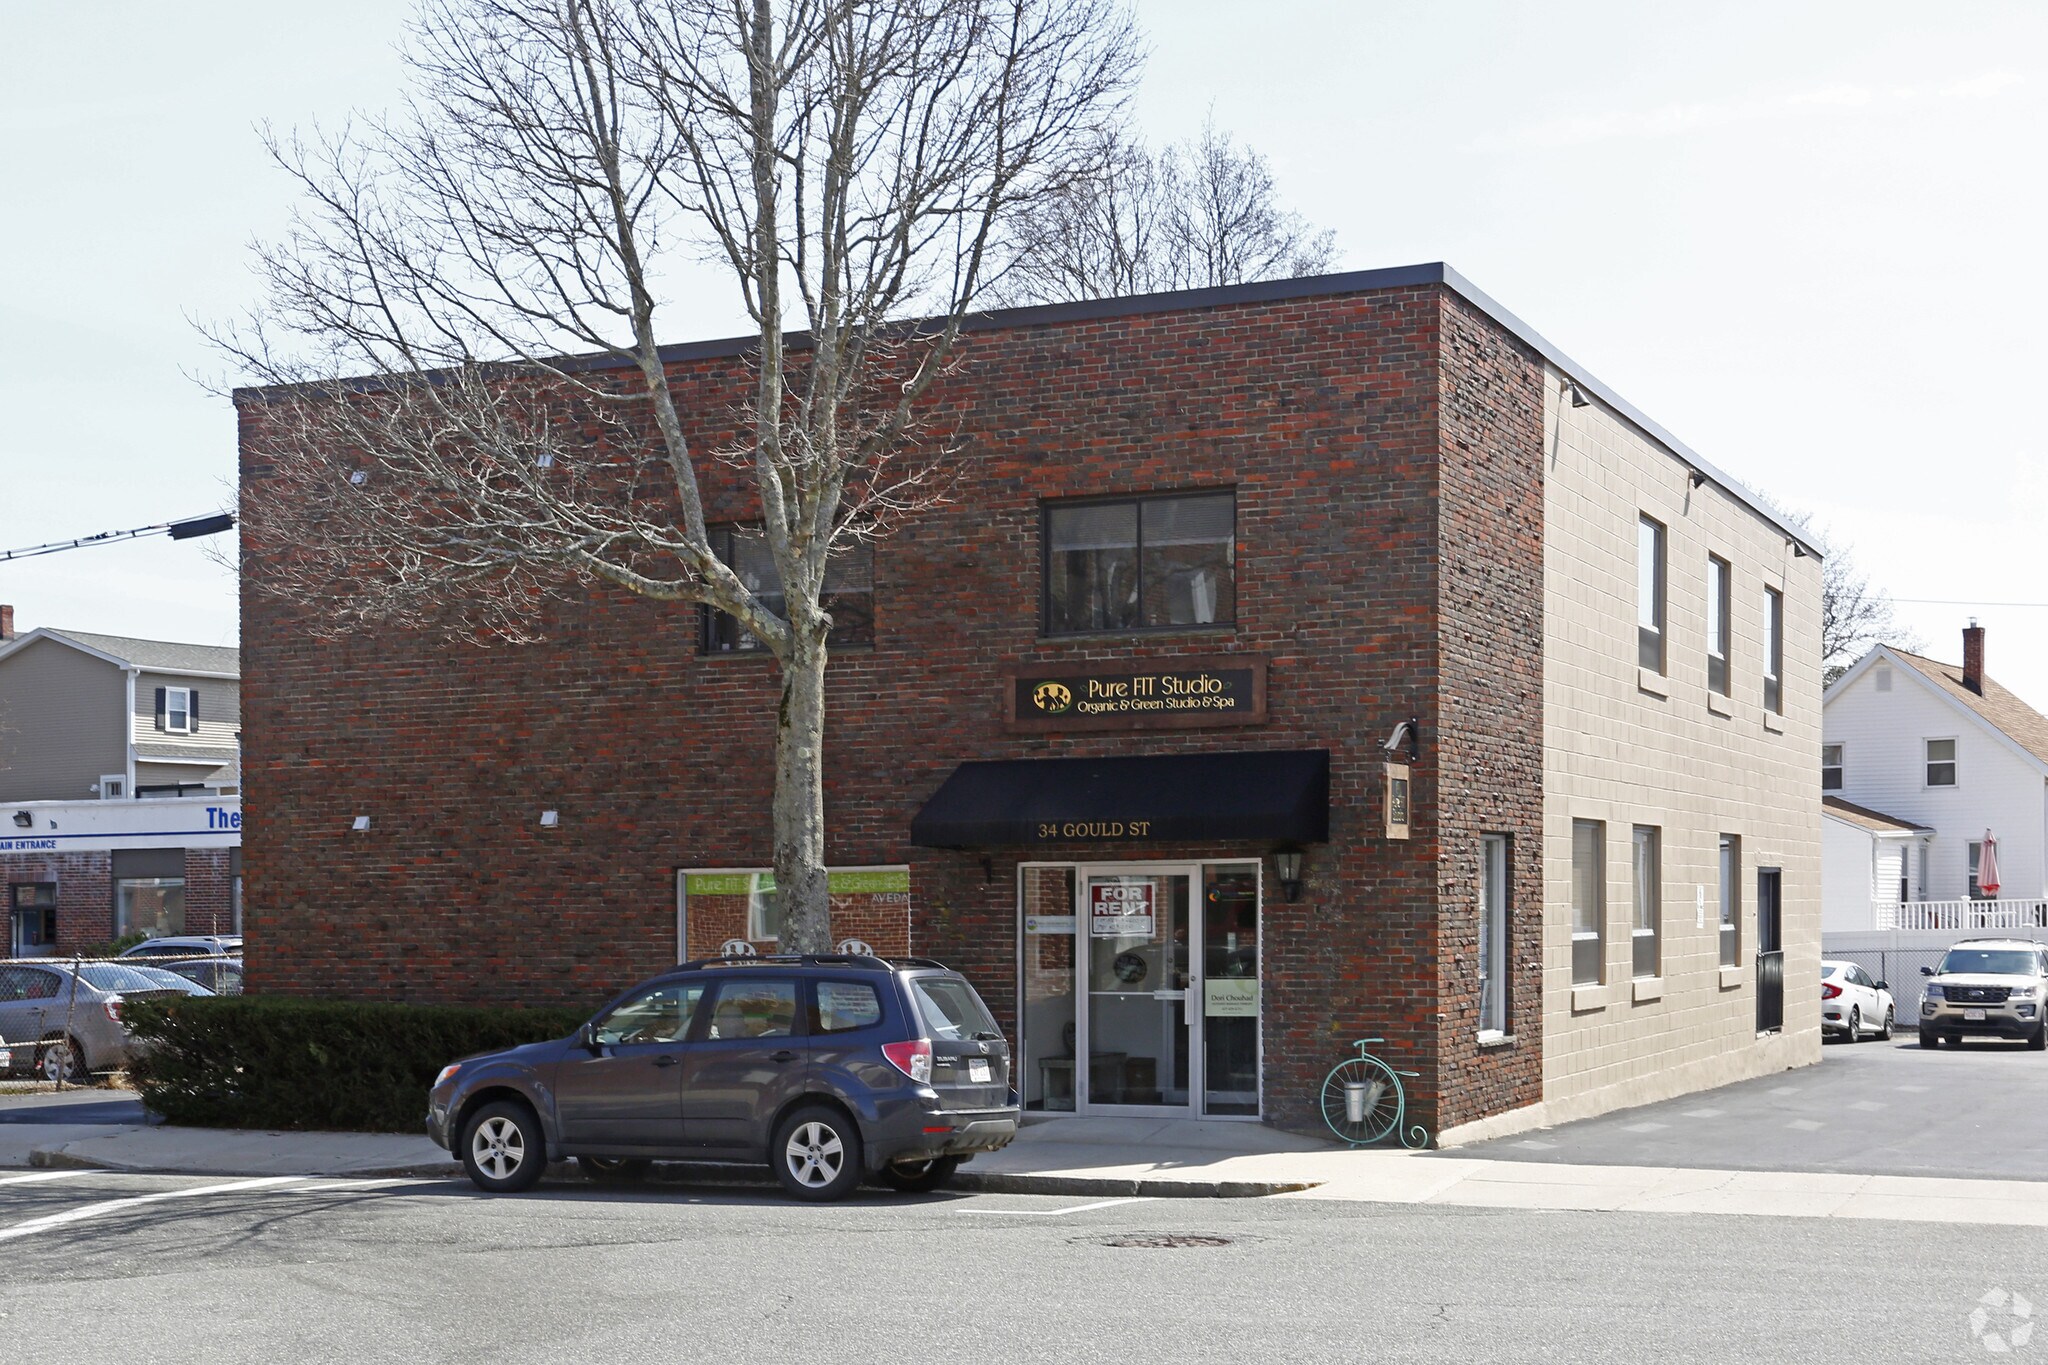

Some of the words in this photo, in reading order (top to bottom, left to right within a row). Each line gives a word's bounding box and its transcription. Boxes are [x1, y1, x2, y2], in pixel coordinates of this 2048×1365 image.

[1089, 679, 1128, 699] Pure
[1133, 676, 1157, 696] FIT
[1161, 674, 1223, 695] Studio
[1077, 700, 1119, 715] Organic
[1119, 699, 1131, 711] &
[1130, 698, 1164, 710] Green
[1165, 696, 1201, 709] Studio
[1202, 696, 1213, 708] &
[1212, 695, 1235, 710] Spa
[206, 807, 241, 829] The
[1038, 823, 1058, 838] 34
[1063, 822, 1124, 837] GOULD
[1129, 821, 1151, 836] ST
[15, 840, 56, 849] ENTRANCE
[696, 878, 722, 891] Pure
[872, 893, 909, 903] AVEDA
[1101, 887, 1142, 901] FOR
[1094, 901, 1150, 915] RENT
